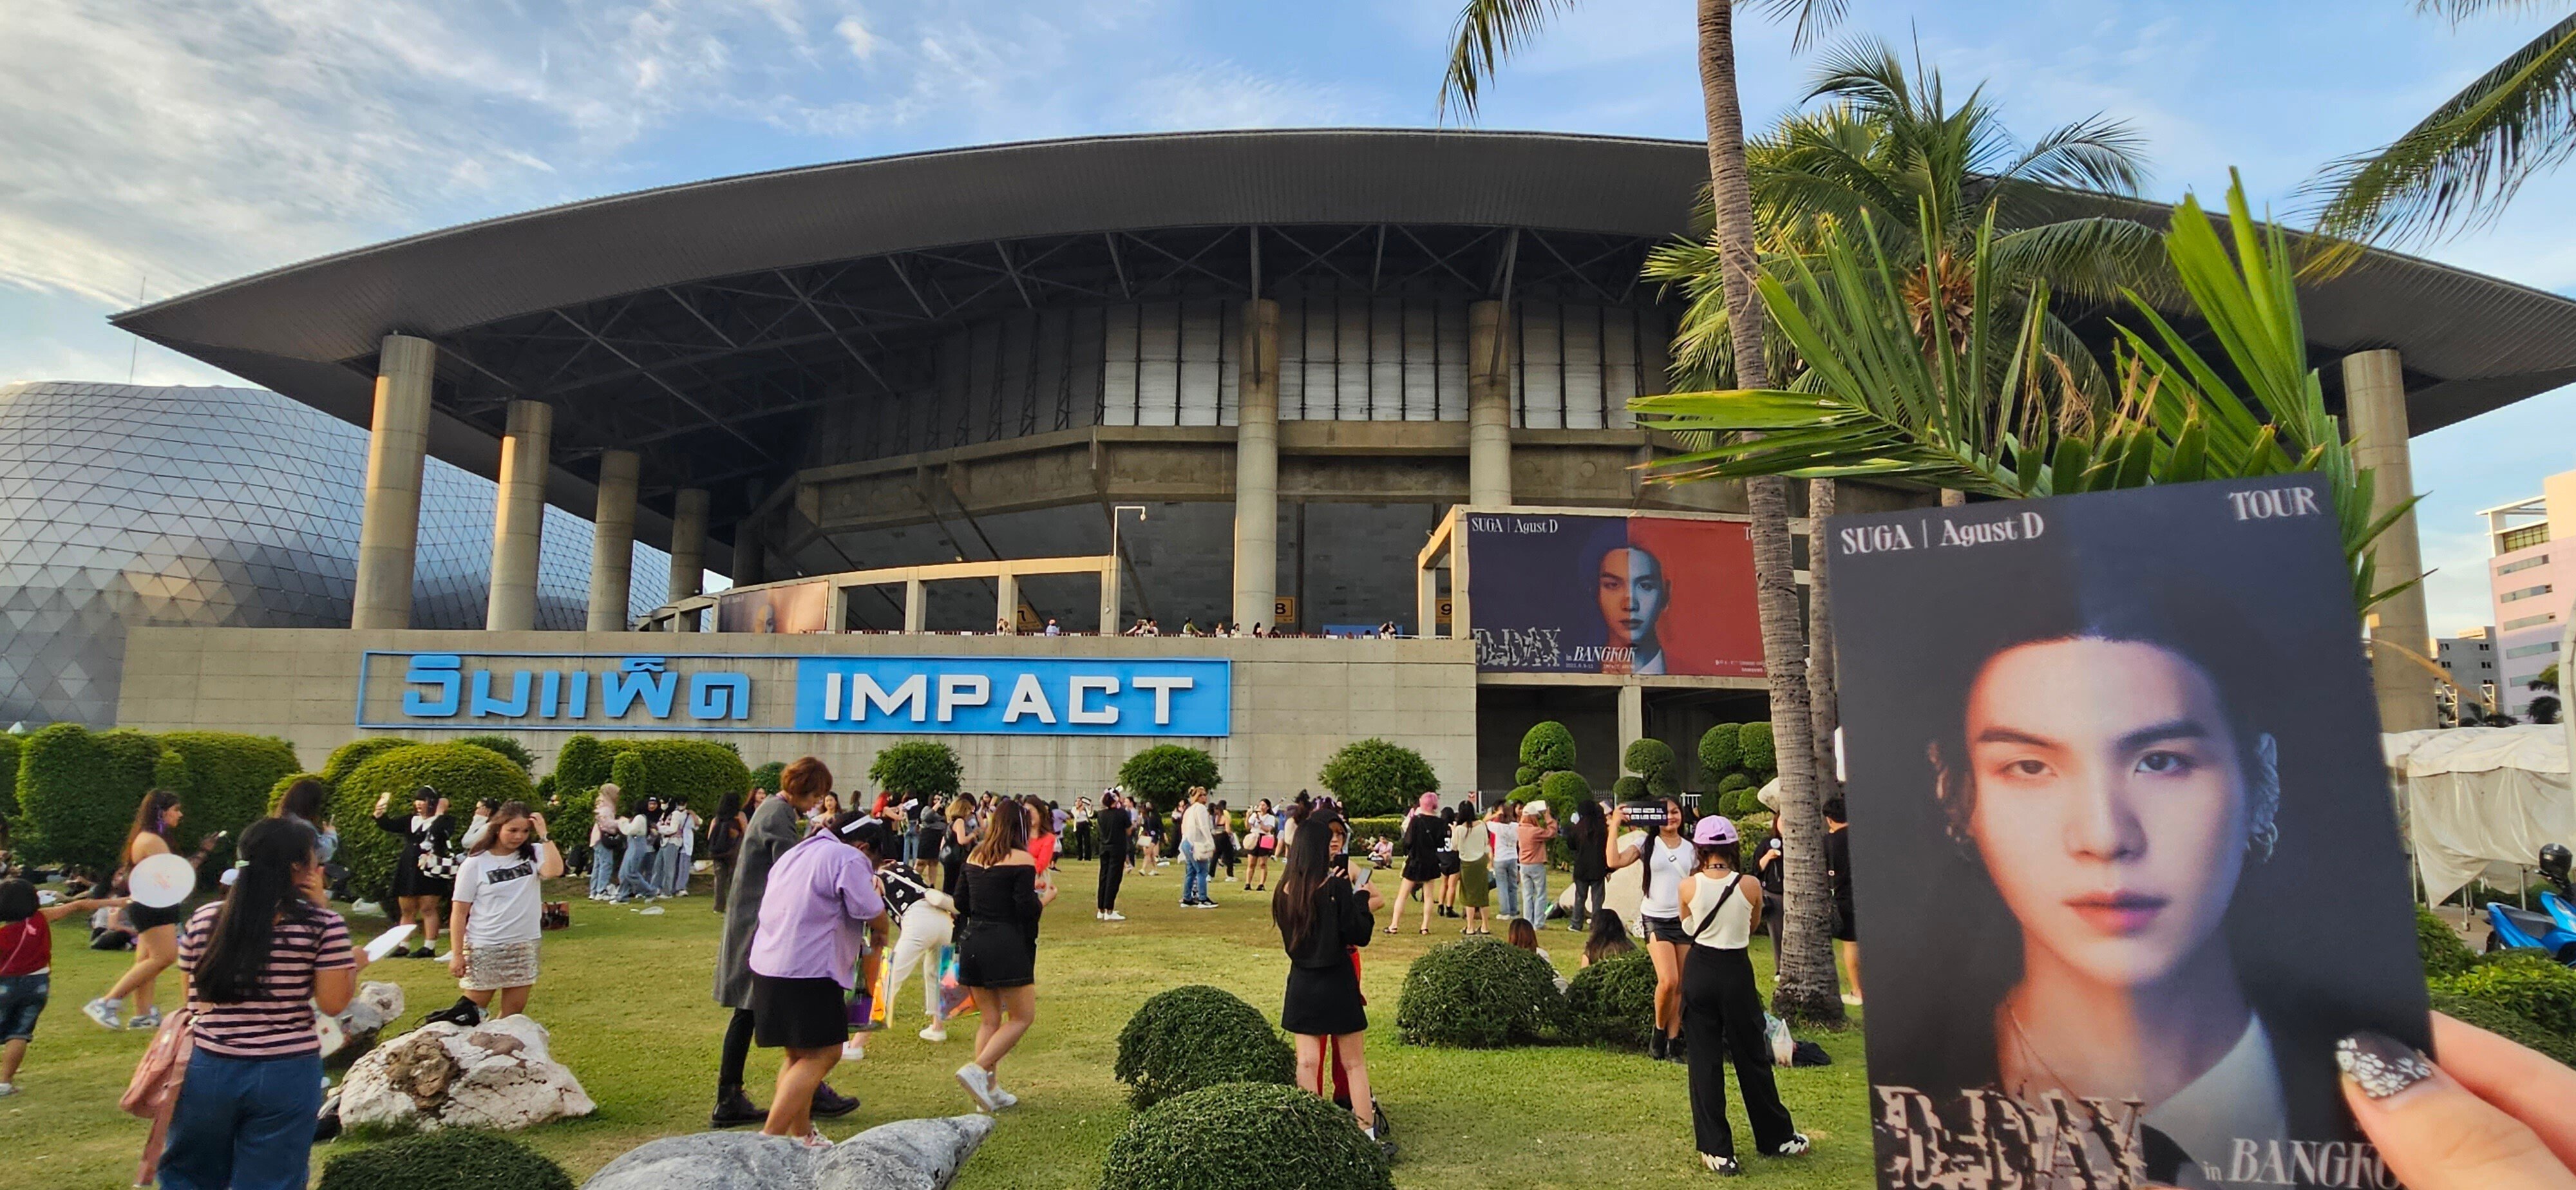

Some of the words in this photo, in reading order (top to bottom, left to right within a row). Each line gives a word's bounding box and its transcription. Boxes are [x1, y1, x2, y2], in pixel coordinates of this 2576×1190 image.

[2228, 486, 2321, 521] TOUR
[1472, 517, 1503, 533] SUGA
[1514, 518, 1548, 534] Agust
[1549, 518, 1558, 533] D
[1840, 524, 1915, 555] SUGA
[1939, 516, 2019, 547] Agust
[2021, 511, 2045, 540] D
[1017, 610, 1027, 621] 7
[1275, 603, 1286, 615] 8
[1441, 603, 1452, 615] 9
[1573, 646, 1638, 663] BANGKOK
[824, 673, 1193, 724] IMPACT
[2203, 1161, 2222, 1181] in
[2228, 1137, 2401, 1190] BANGKO
